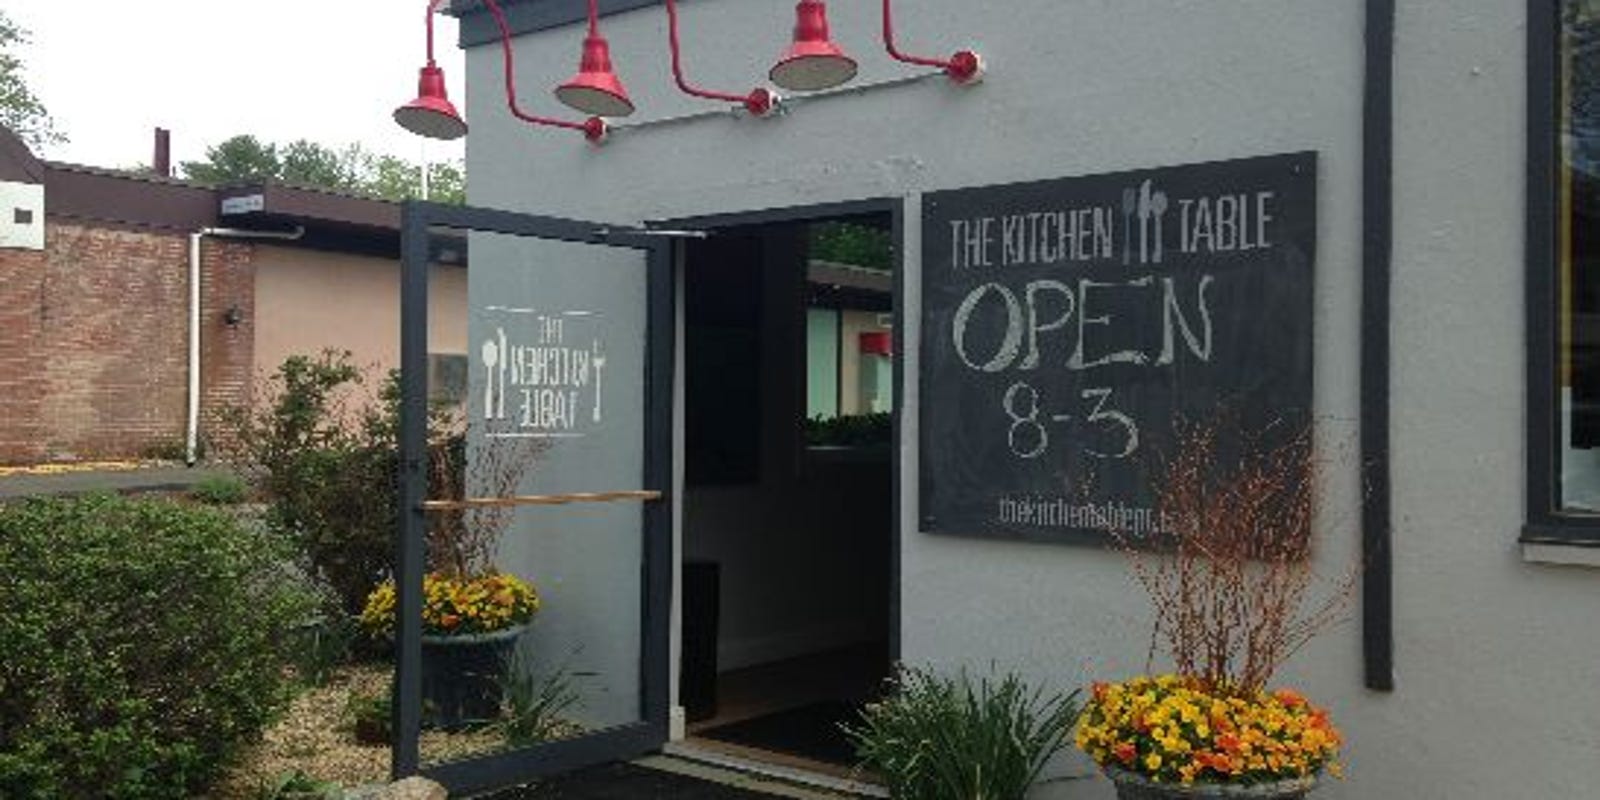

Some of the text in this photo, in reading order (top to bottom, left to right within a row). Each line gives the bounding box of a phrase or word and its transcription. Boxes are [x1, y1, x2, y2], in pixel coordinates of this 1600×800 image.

[950, 192, 1274, 268] THE KITCHEN TABLE
[952, 276, 1214, 371] OPEN
[1003, 382, 1139, 458] 8-3
